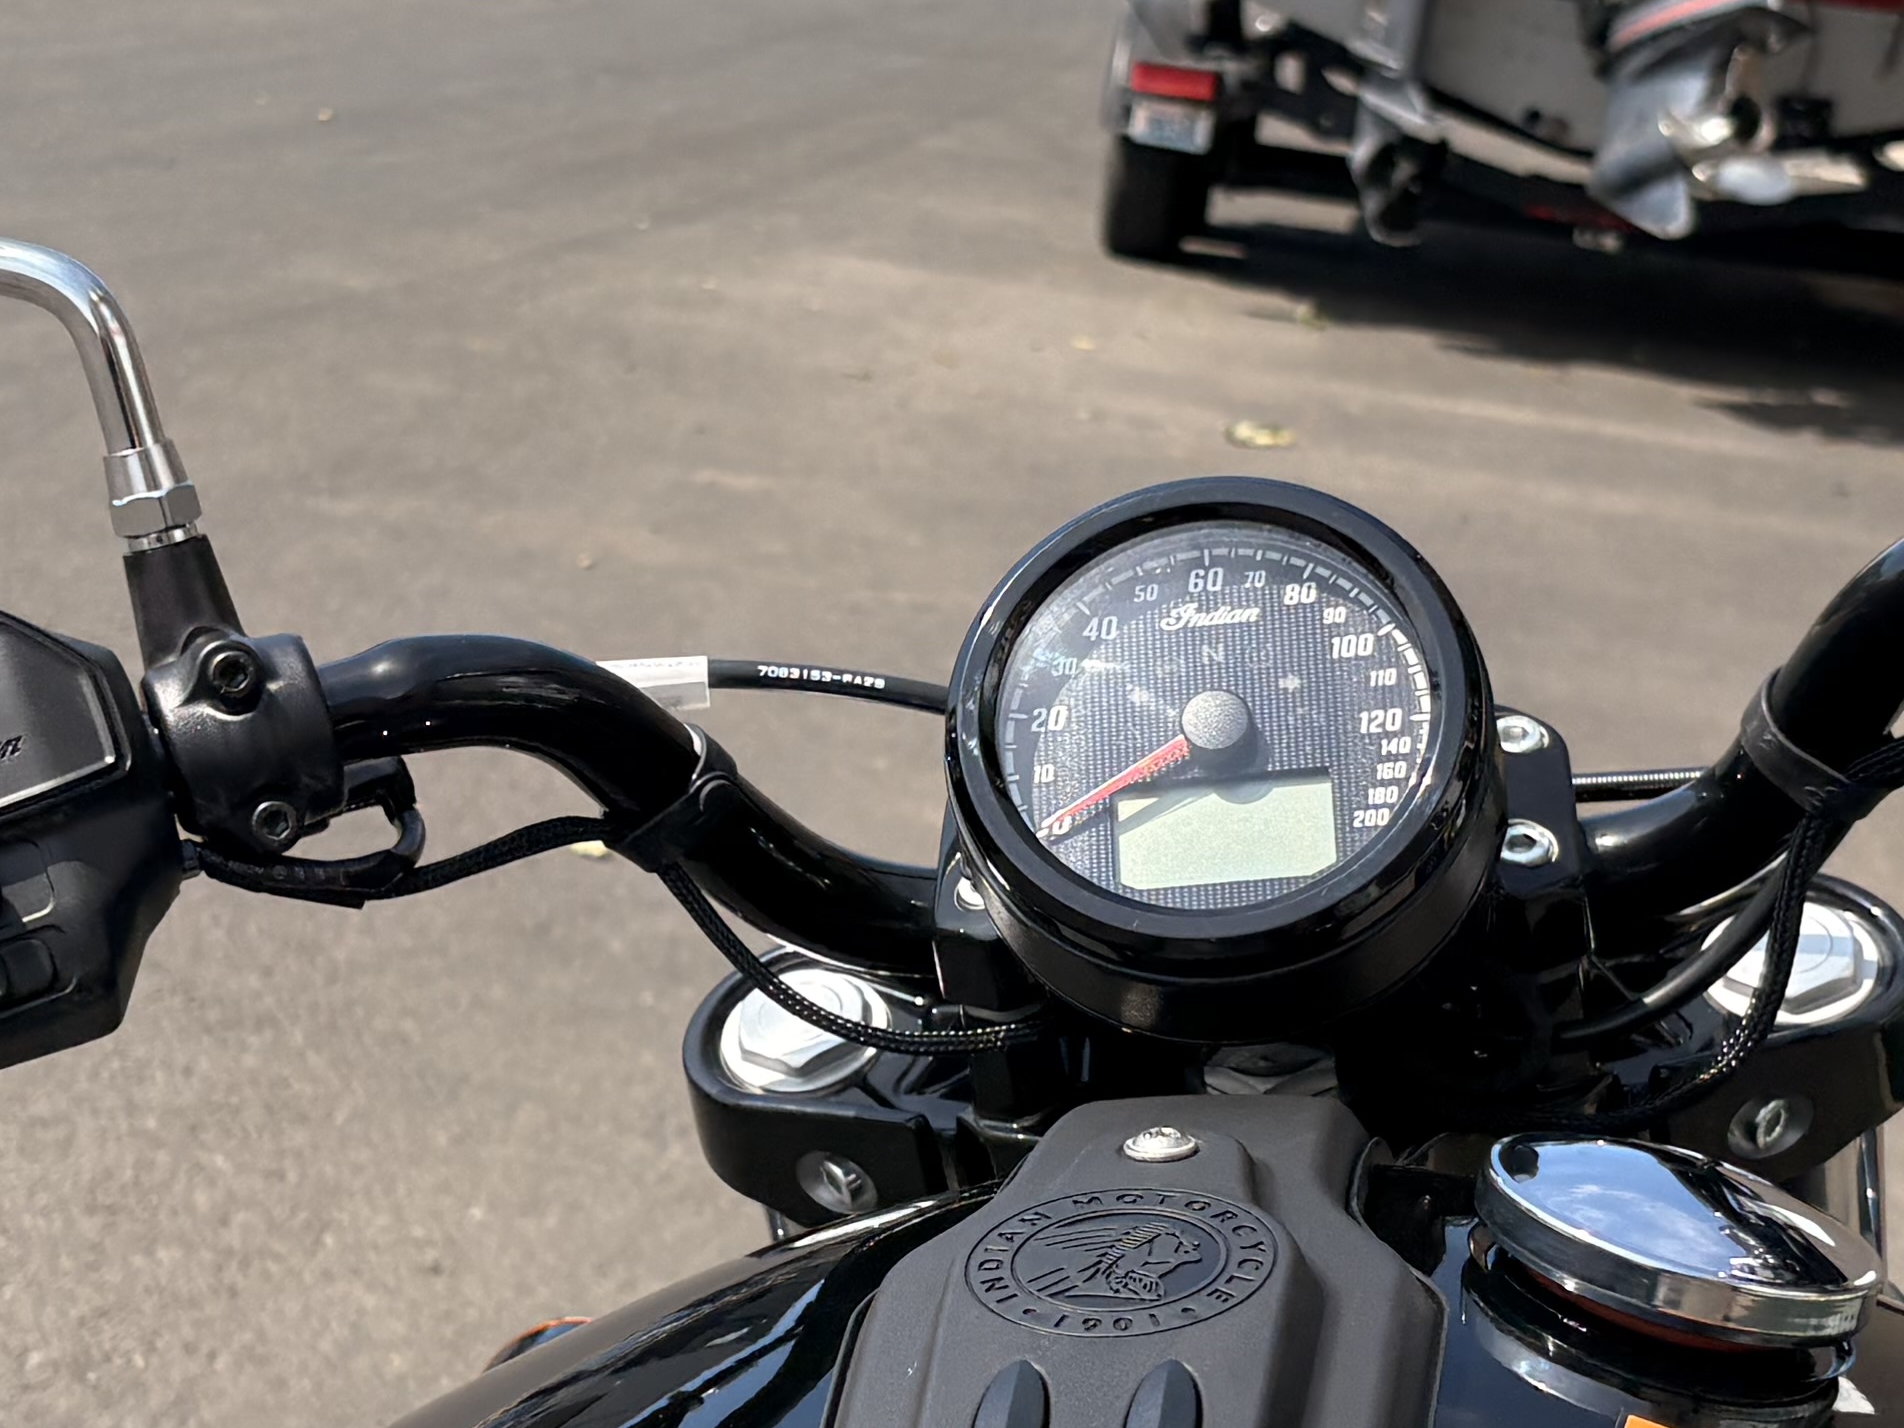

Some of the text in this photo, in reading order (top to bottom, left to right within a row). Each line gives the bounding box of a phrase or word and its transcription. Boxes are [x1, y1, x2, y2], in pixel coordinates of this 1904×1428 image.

[1187, 567, 1224, 593] 60
[1244, 570, 1267, 590] 70
[1133, 584, 1160, 603] 50
[1283, 582, 1318, 606] 80
[1159, 601, 1261, 632] Indian
[1322, 606, 1348, 626] 90
[1082, 615, 1119, 642] 40
[1331, 633, 1375, 659] 100
[1051, 657, 1079, 677] 30
[1369, 668, 1397, 687] 110
[1031, 705, 1067, 733] 20
[1359, 708, 1403, 734] 120
[1381, 737, 1412, 756] 140
[1033, 763, 1056, 784] 10
[1377, 760, 1408, 781] 160
[1368, 785, 1399, 805] 180
[1352, 807, 1391, 828] 200
[978, 1192, 1264, 1304] INDIAN MOTORCYCLE
[1053, 1312, 1161, 1333] 1901
